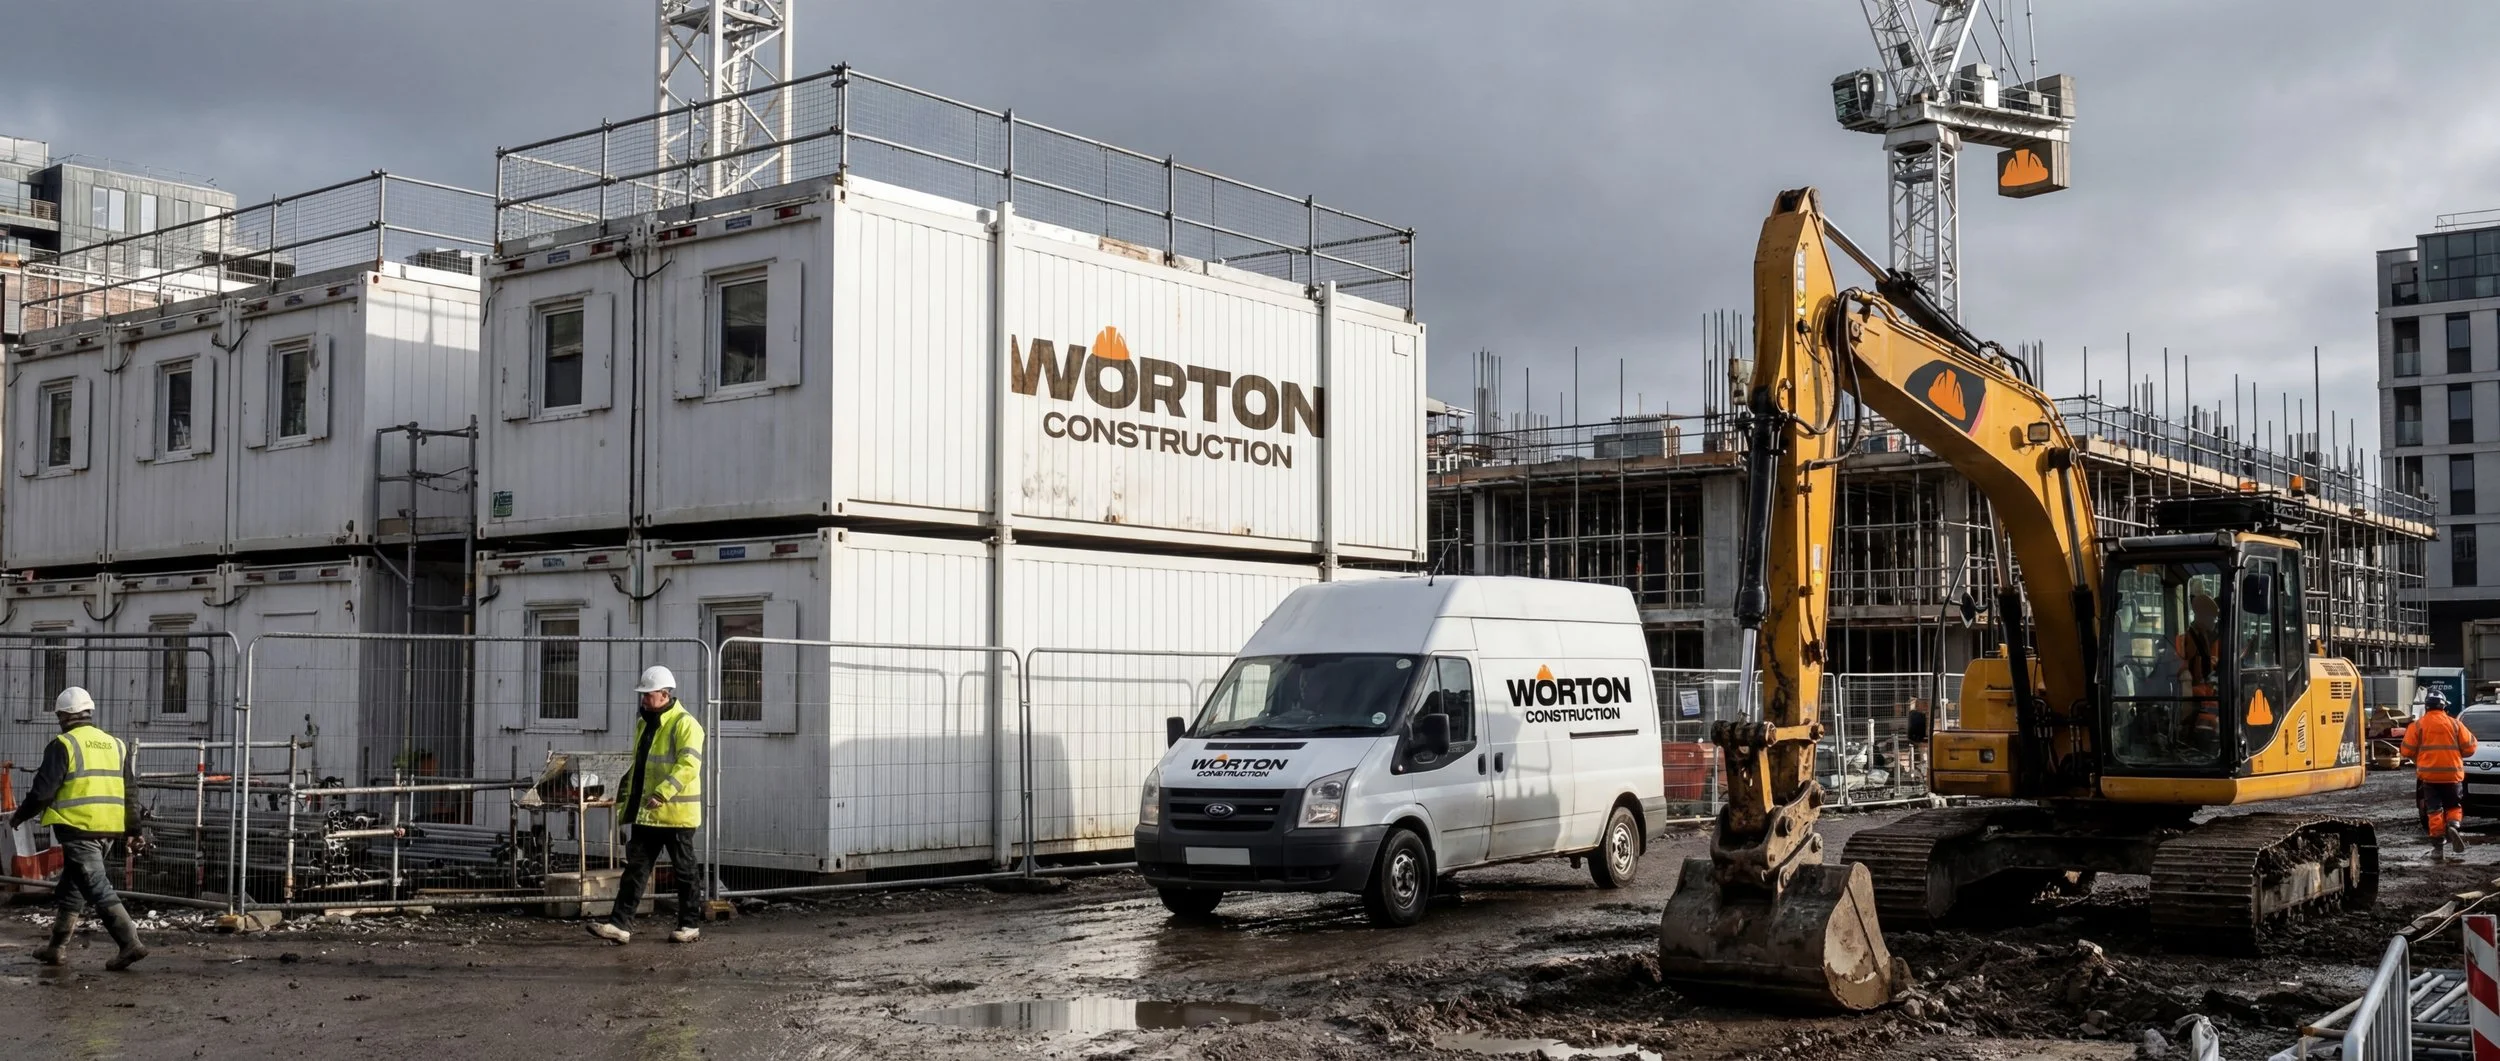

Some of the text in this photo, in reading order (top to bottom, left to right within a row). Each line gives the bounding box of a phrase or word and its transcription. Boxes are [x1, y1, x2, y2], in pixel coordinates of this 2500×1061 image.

[1011, 333, 1325, 439] WORTON
[1043, 411, 1292, 469] CONSTRUCTION
[1506, 677, 1632, 707] WORTON
[1525, 707, 1621, 724] CONSTRUCTION
[1191, 758, 1289, 770] WORTON
